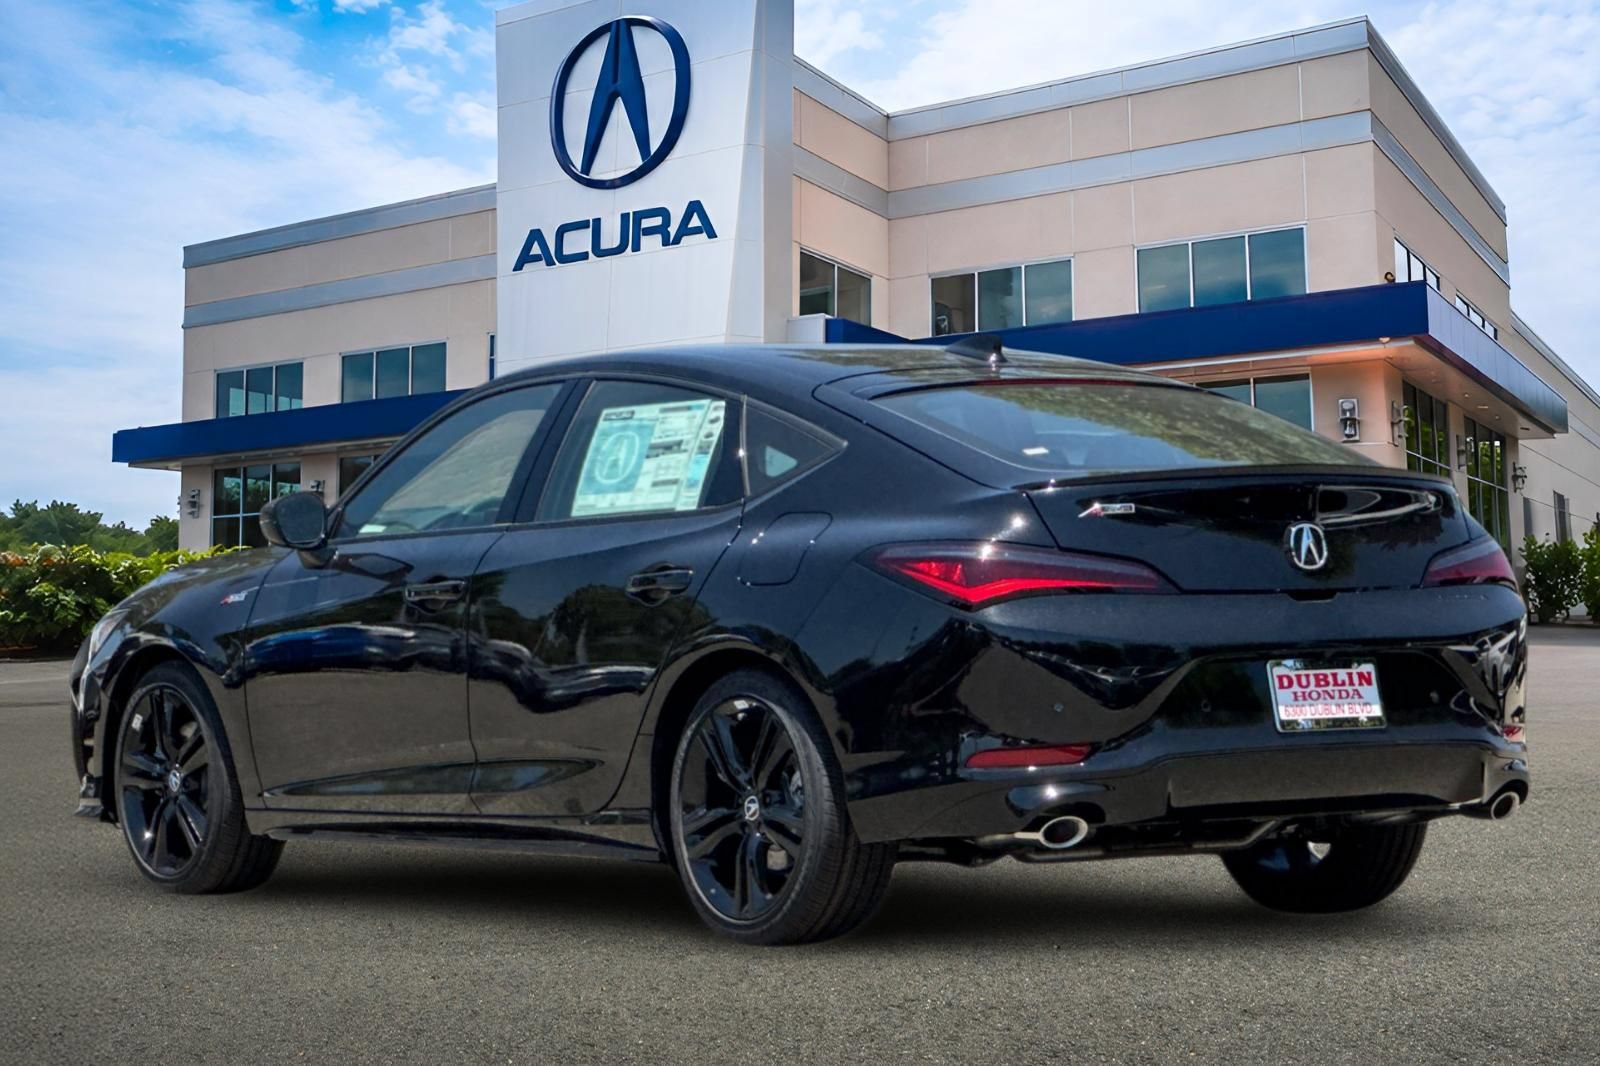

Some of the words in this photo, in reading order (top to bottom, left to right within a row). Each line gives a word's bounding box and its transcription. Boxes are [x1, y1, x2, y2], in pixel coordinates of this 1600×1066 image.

[512, 199, 718, 272] ACURA
[1276, 671, 1373, 690] DUBLIN
[1292, 688, 1364, 702] HONDA
[1309, 703, 1345, 717] DUBLIN
